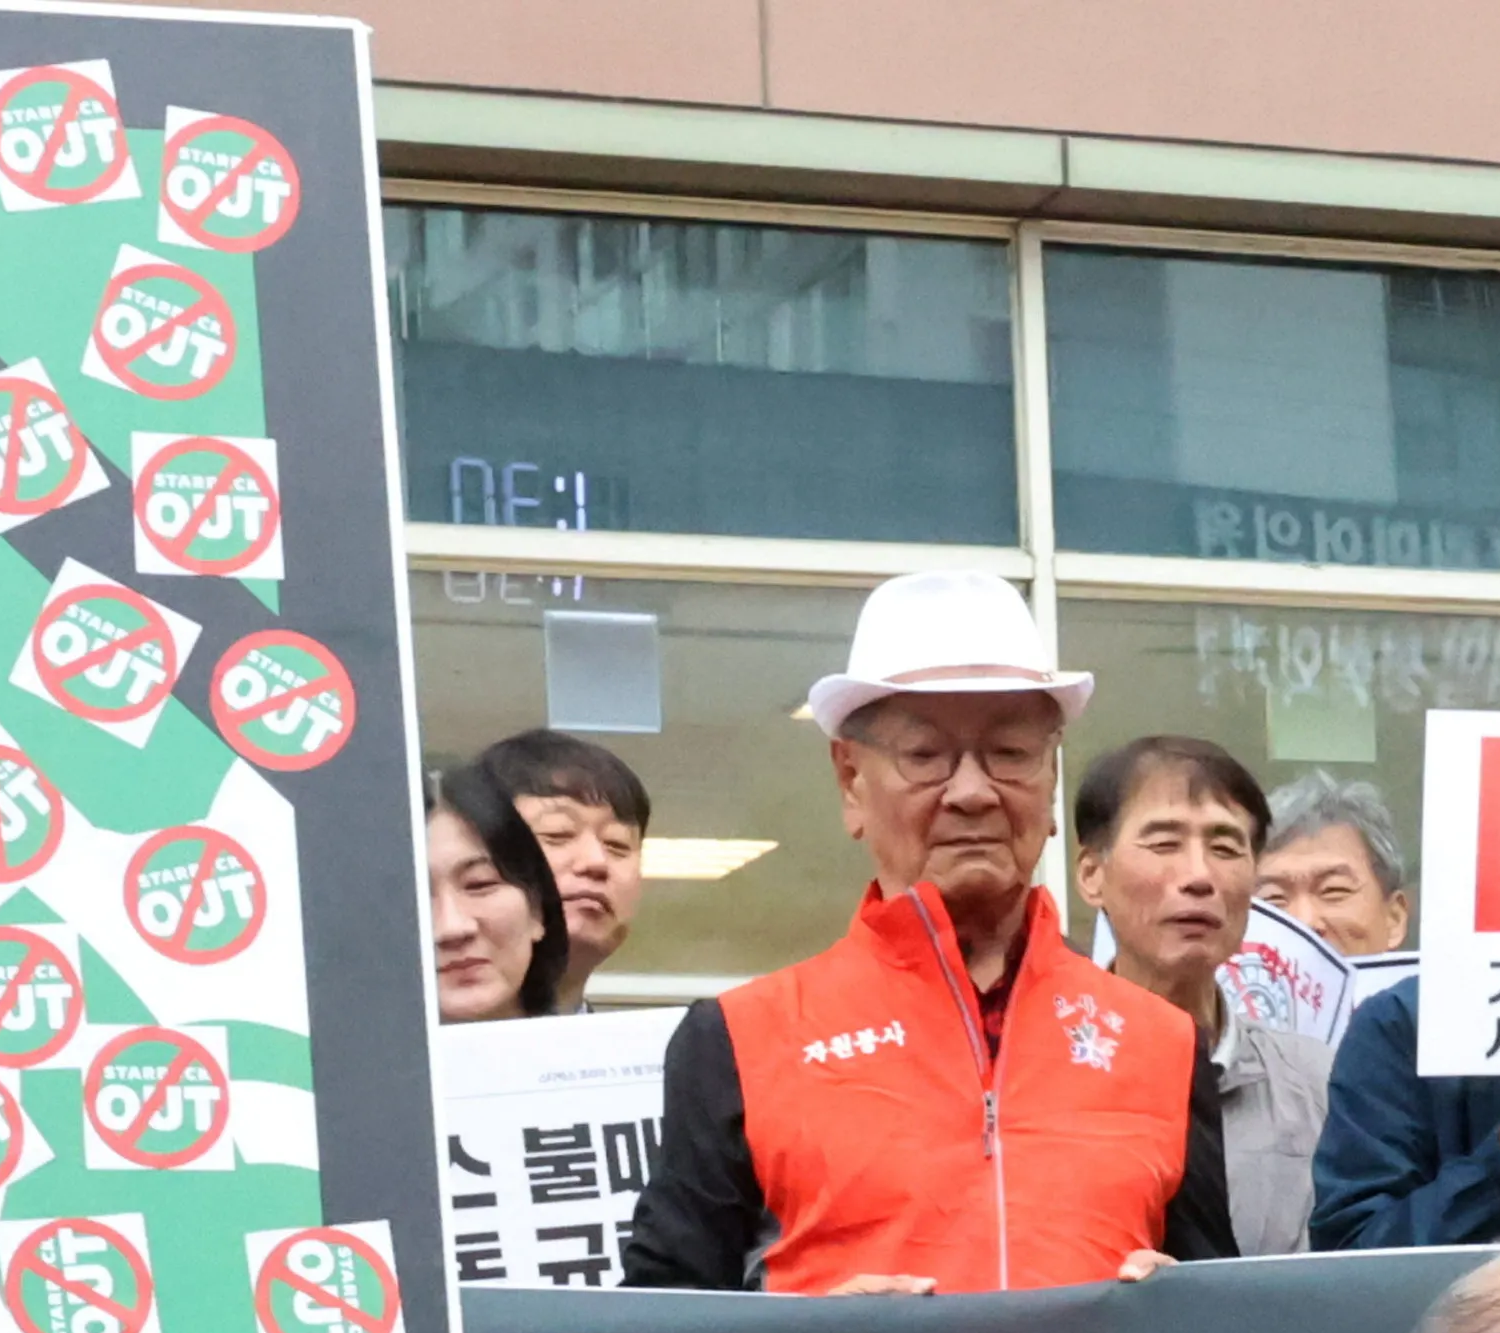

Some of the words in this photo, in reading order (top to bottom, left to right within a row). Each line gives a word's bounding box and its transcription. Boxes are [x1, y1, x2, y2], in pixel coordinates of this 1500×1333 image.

[0, 117, 119, 173] OUT
[168, 165, 291, 225] OUT
[102, 304, 227, 381] OUT
[145, 492, 270, 542] OUT
[41, 621, 167, 707] OUT
[219, 666, 345, 755] OUT
[138, 870, 257, 938] OUT
[803, 1020, 906, 1064] 자원봉사
[96, 1084, 221, 1132] OUT
